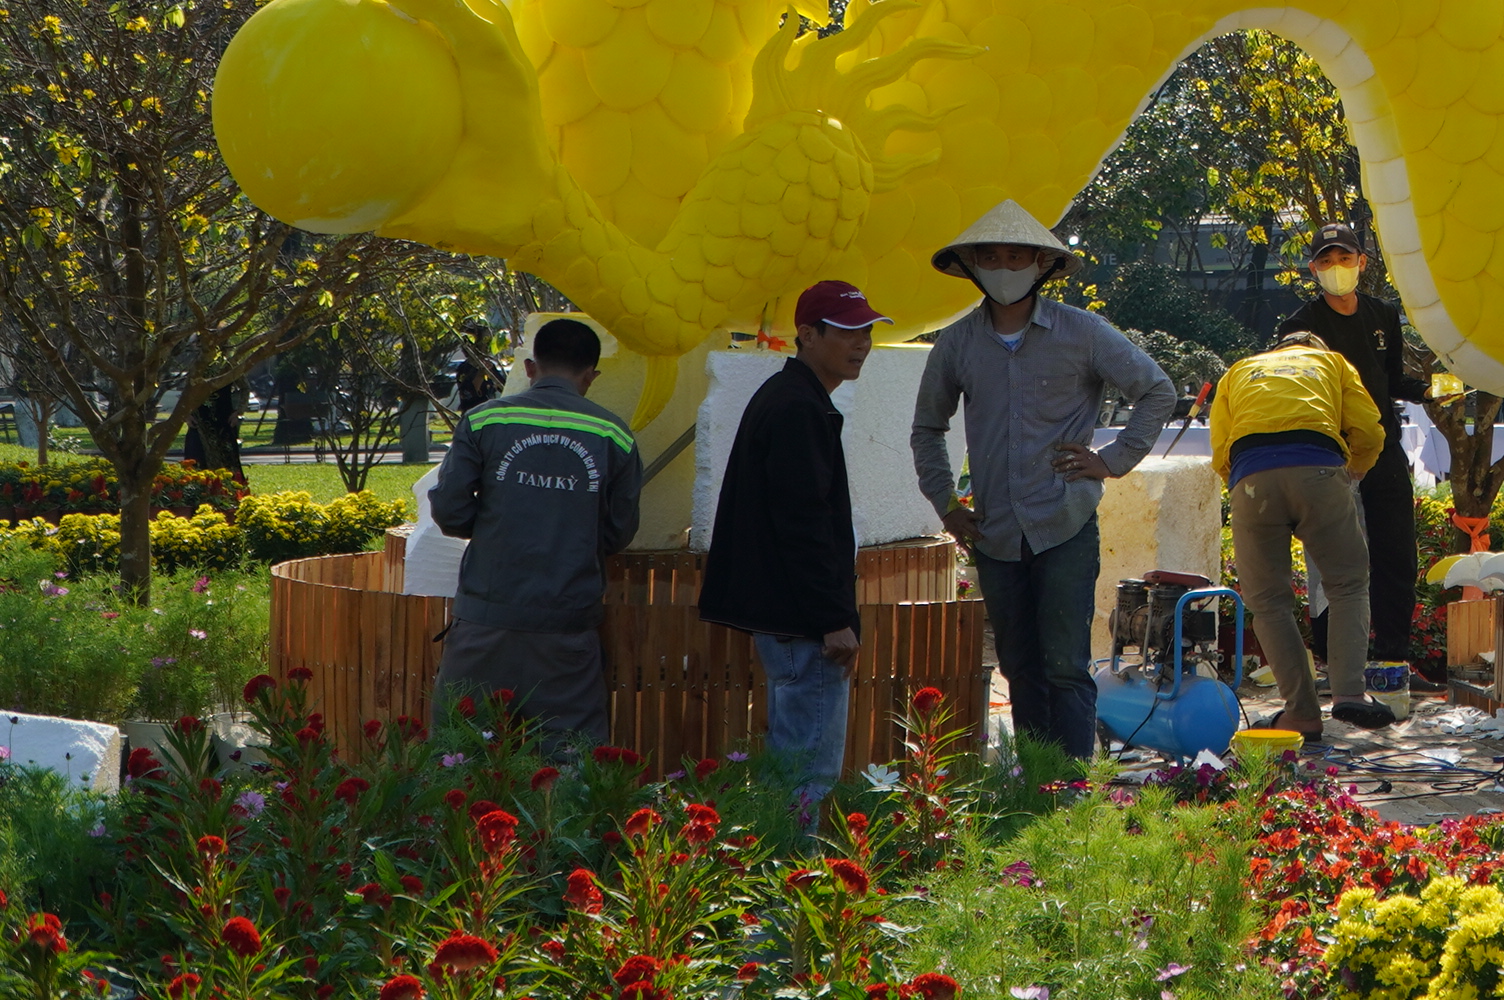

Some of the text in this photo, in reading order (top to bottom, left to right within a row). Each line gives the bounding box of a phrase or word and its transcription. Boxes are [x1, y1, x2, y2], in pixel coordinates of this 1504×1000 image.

[496, 460, 510, 481] CÔNG
[504, 451, 515, 462] TY
[569, 440, 588, 458] CÔNG
[516, 470, 579, 491] TAM KỲ
